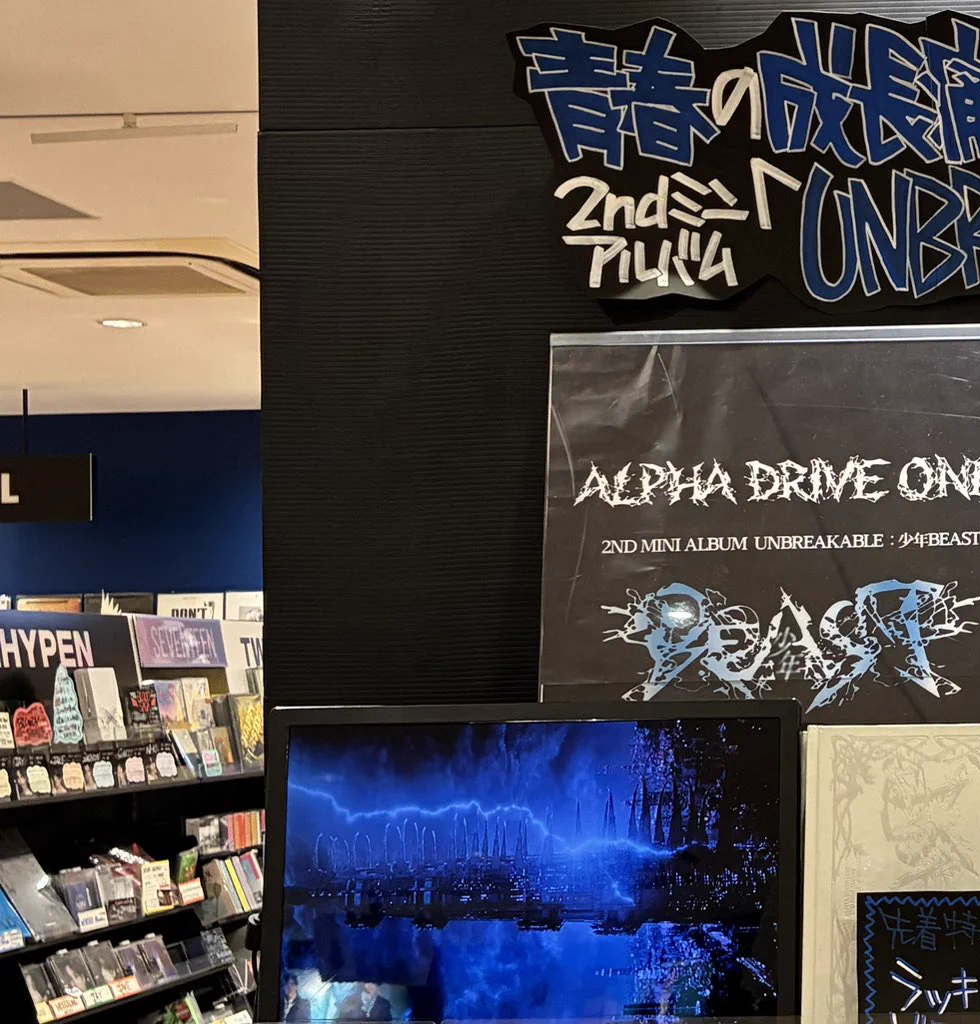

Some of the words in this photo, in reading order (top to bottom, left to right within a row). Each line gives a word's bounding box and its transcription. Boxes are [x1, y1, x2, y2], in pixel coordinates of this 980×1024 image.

[562, 229, 738, 289] アルバム
[573, 457, 738, 507] ALPHA
[746, 454, 893, 503] DRIVE
[601, 538, 637, 555] 2ND
[641, 537, 681, 554] MINI
[684, 536, 748, 552] ALBUM
[754, 533, 884, 551] UNBREAKABLE
[0, 628, 95, 668] HYPEN
